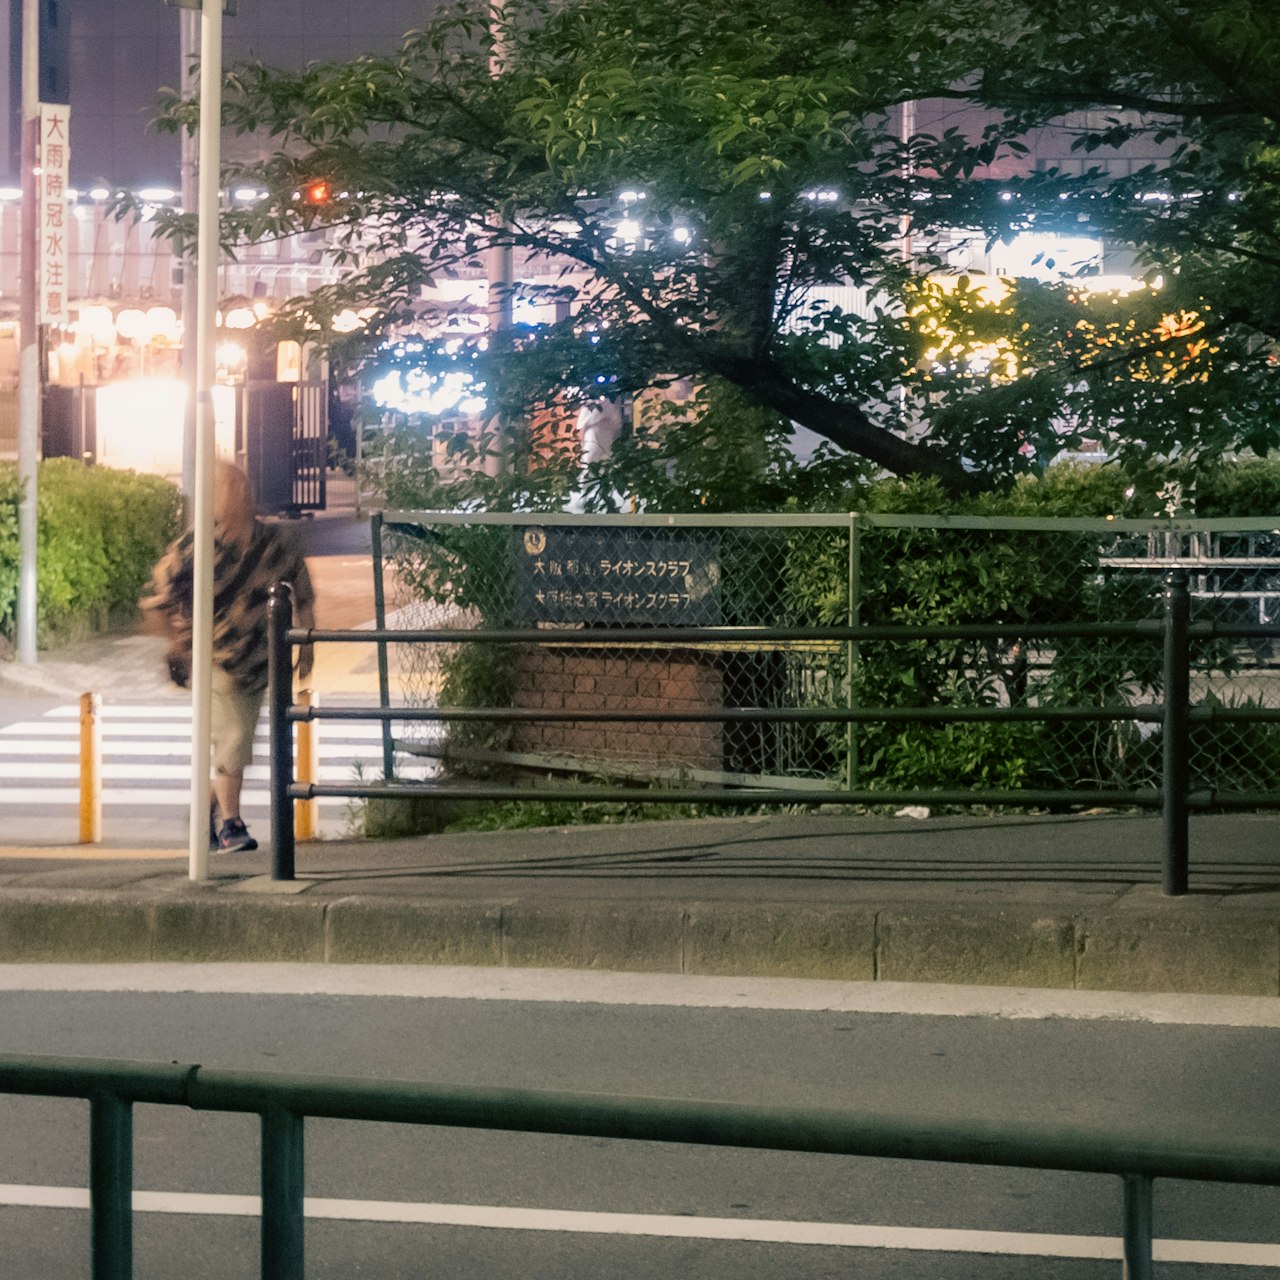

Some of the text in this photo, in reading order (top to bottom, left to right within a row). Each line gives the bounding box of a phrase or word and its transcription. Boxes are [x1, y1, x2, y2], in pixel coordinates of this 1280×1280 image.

[46, 114, 64, 316] 大雨時冠水注意
